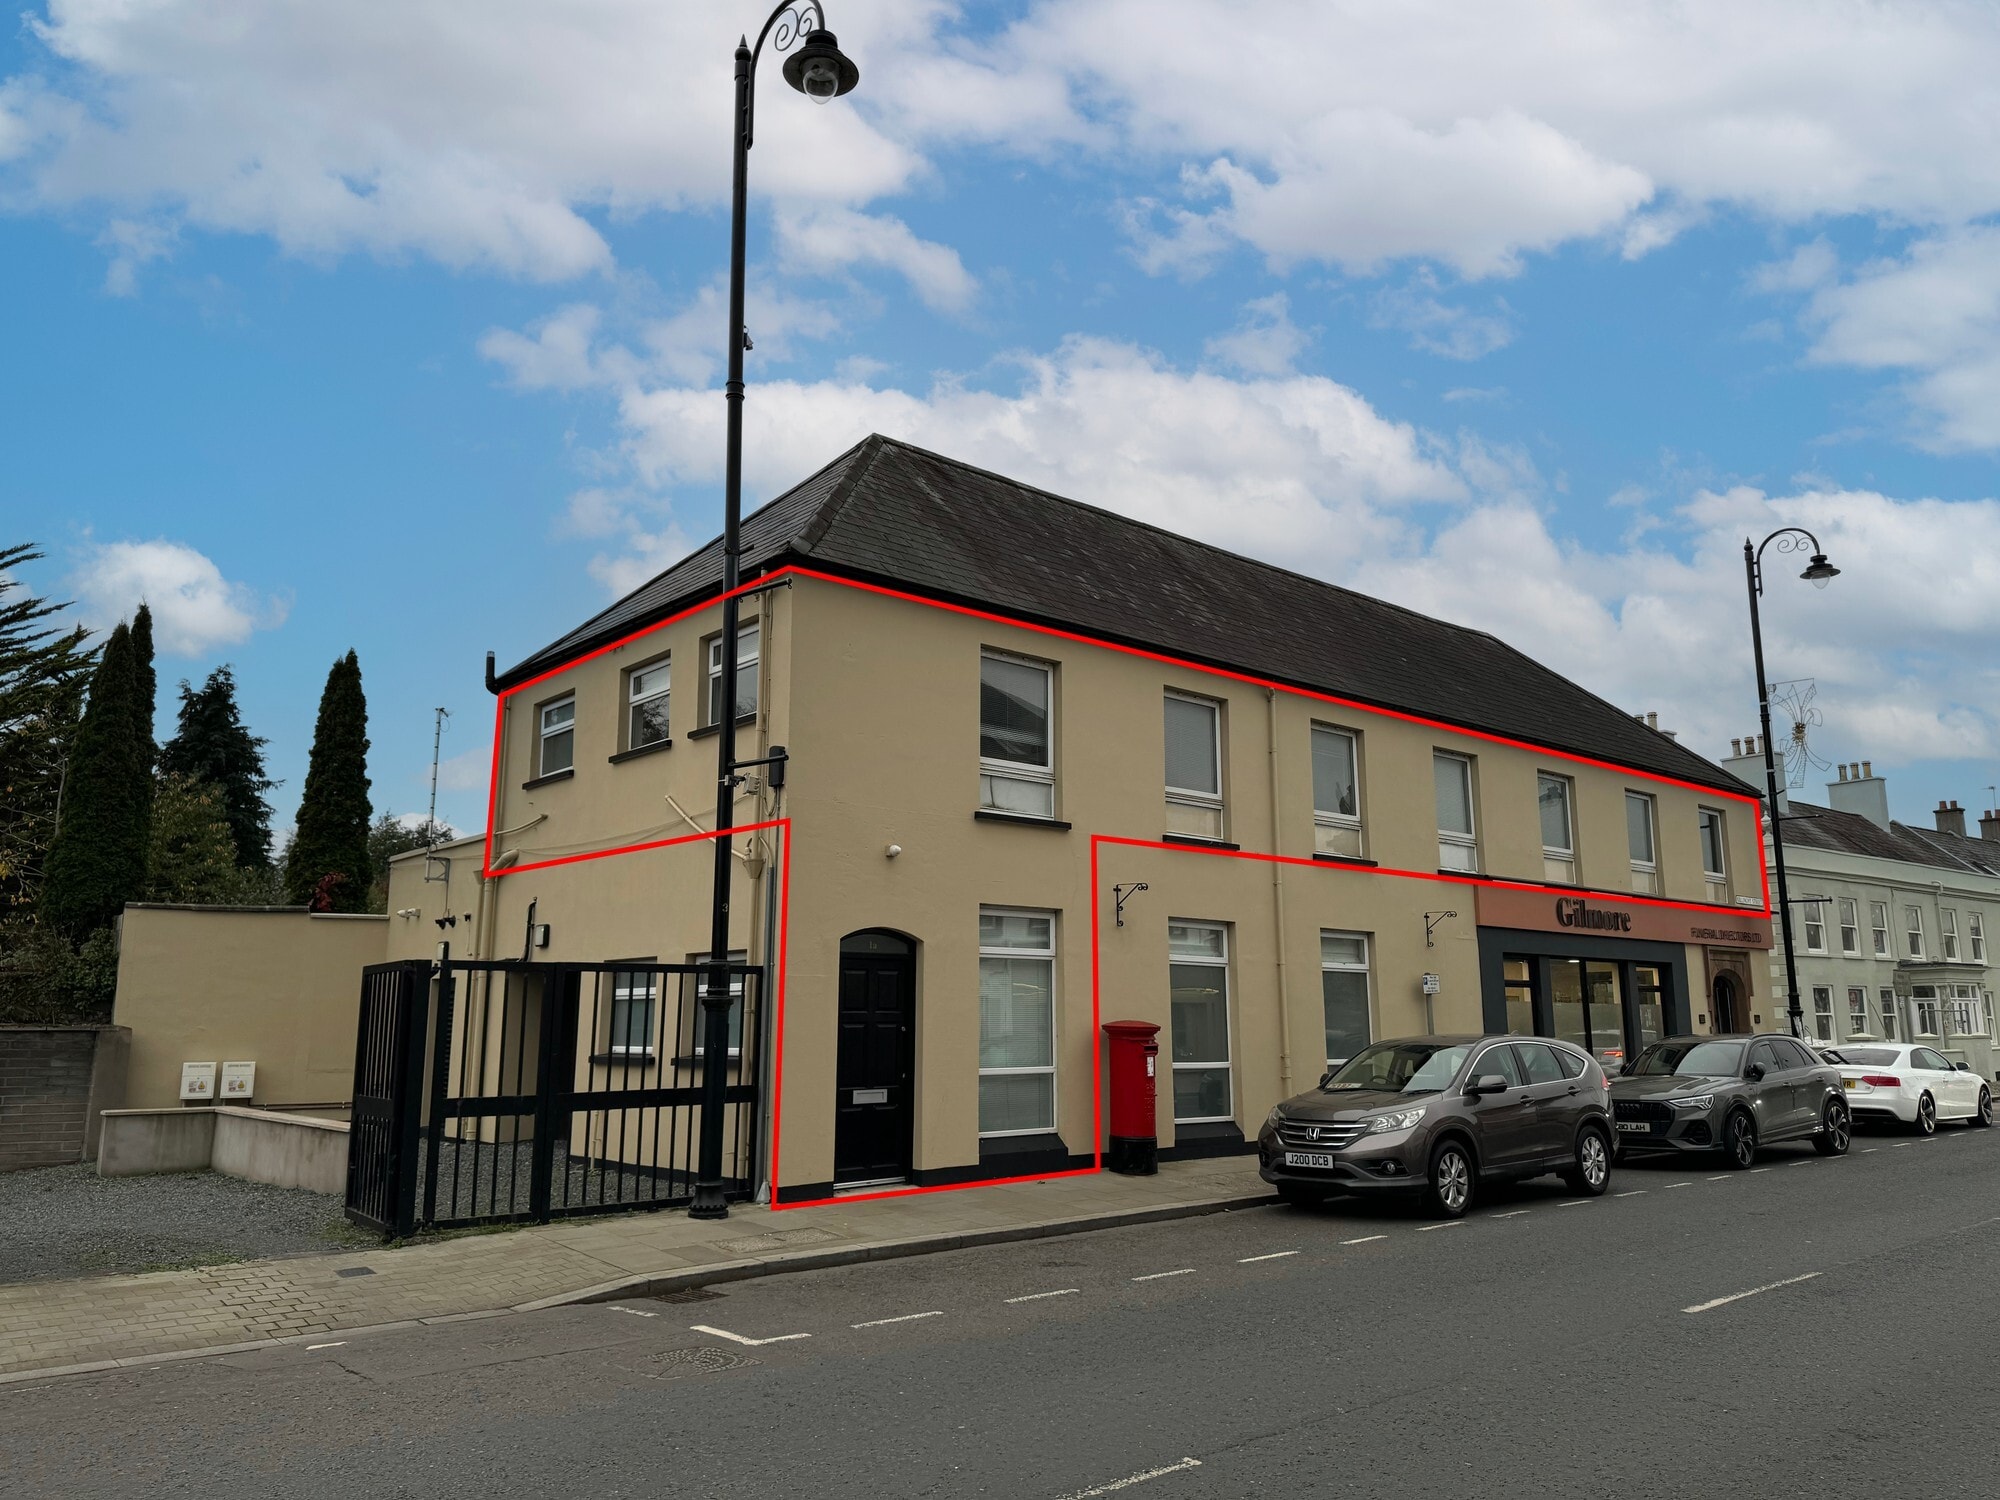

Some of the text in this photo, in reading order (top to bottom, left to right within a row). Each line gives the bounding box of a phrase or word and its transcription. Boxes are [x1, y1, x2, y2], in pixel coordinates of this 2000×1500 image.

[1556, 897, 1631, 931] Gilmore
[1289, 1153, 1329, 1166] J200 DCB
